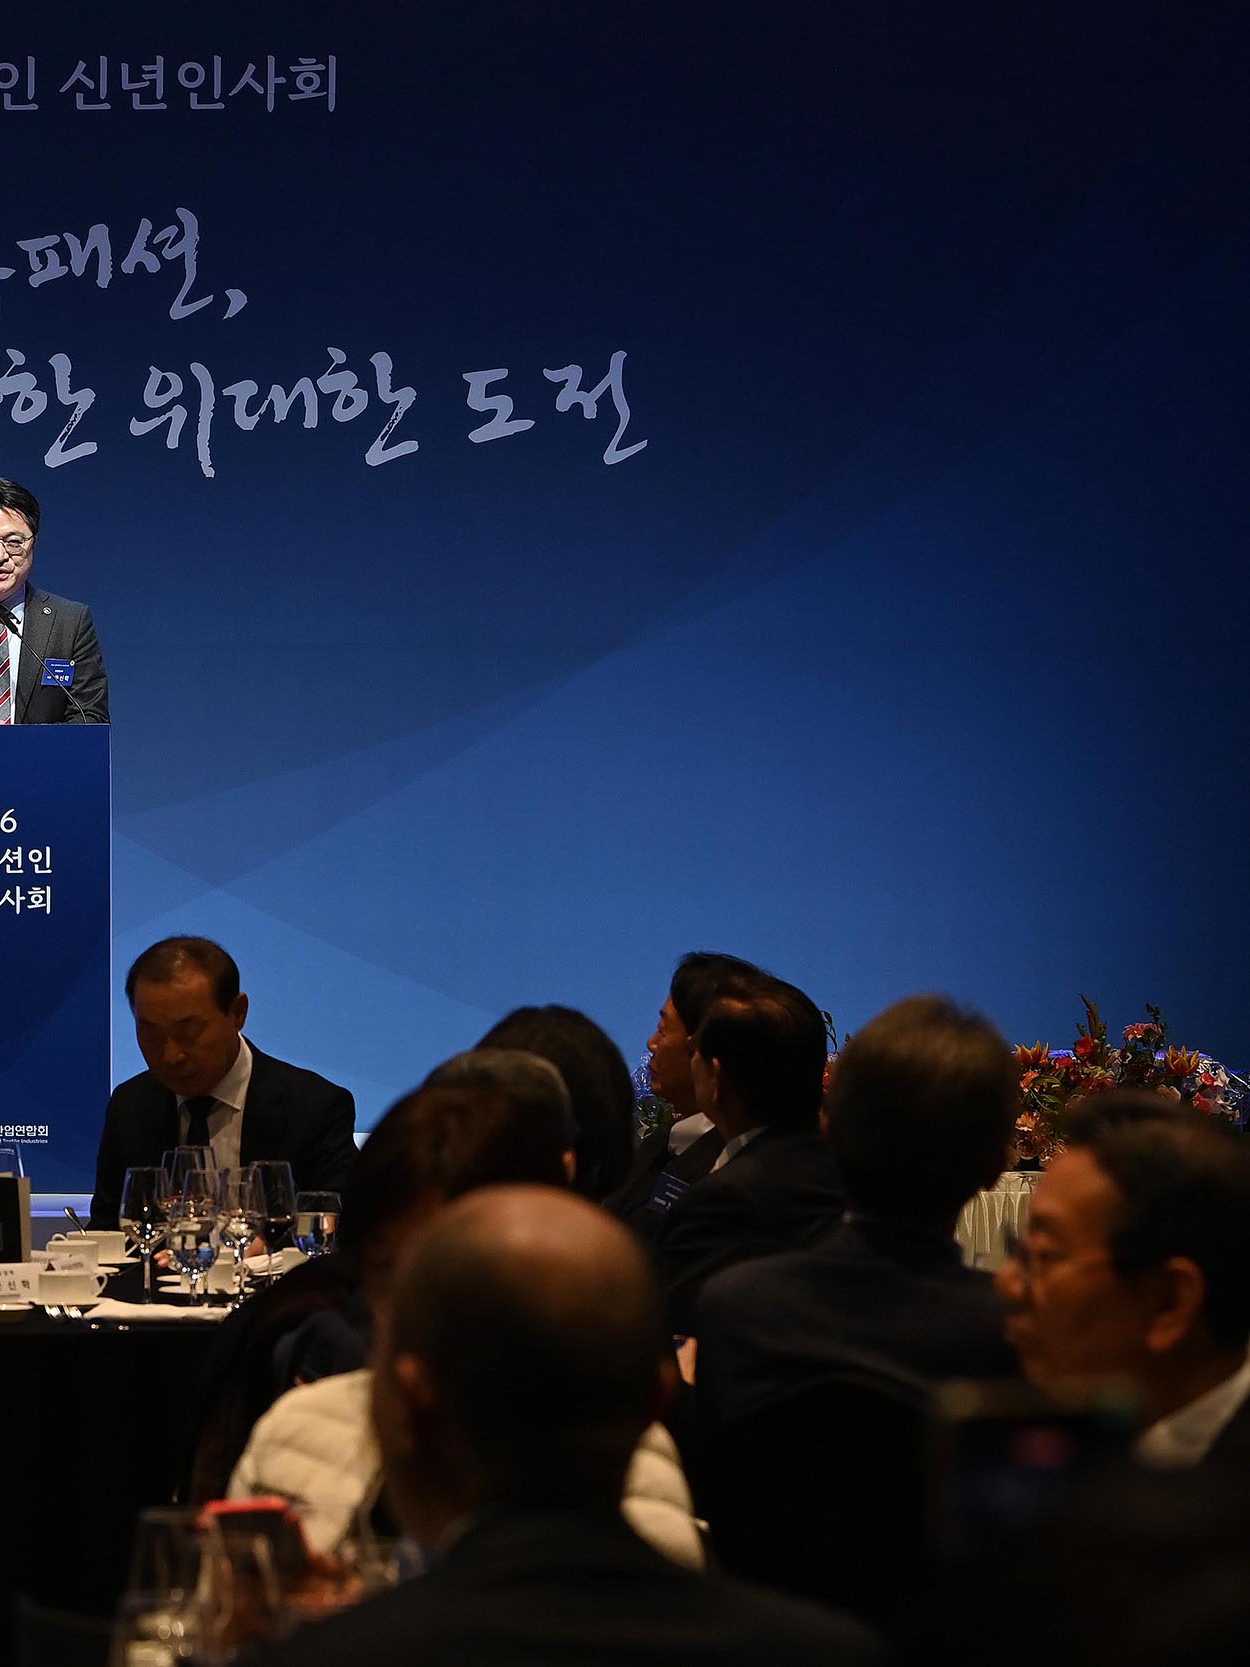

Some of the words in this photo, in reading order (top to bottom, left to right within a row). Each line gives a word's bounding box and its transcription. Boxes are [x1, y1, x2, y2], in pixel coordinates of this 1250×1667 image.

[59, 54, 338, 113] 신년인사회
[129, 346, 420, 478] 위대한
[462, 350, 649, 466] 도전
